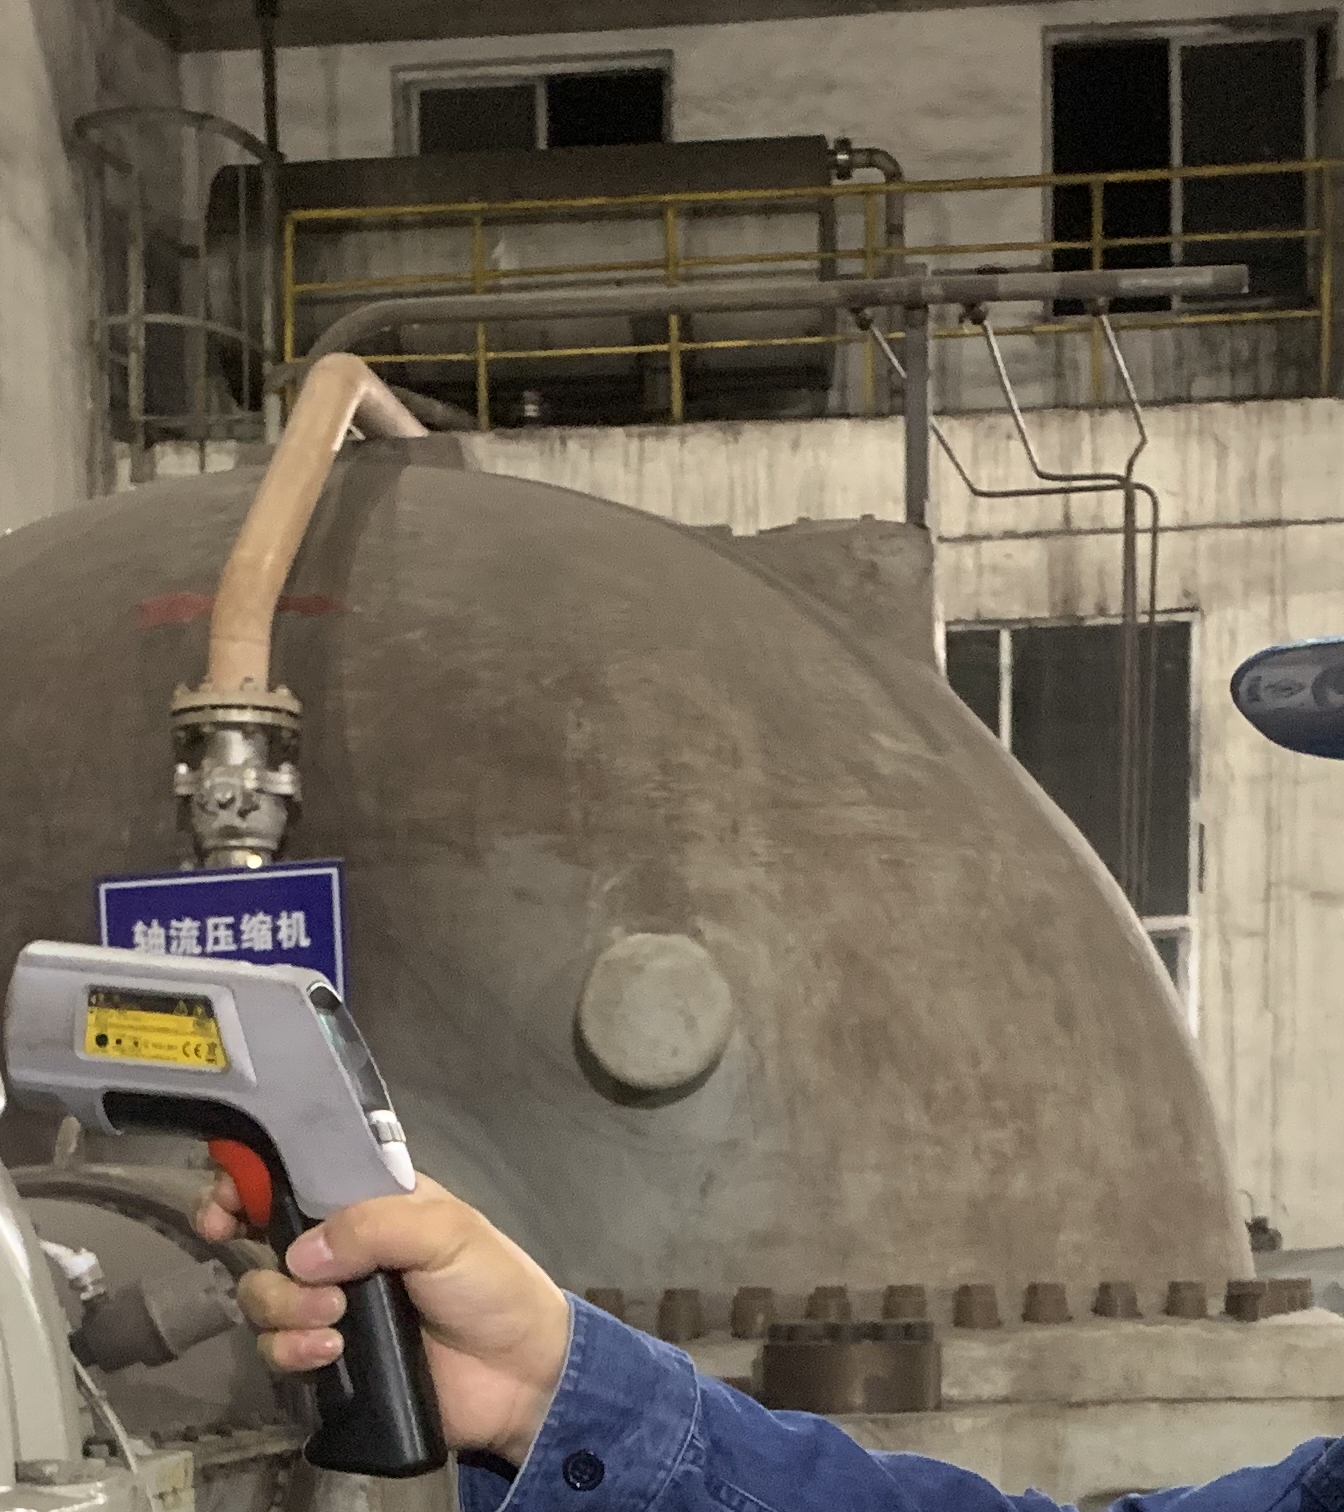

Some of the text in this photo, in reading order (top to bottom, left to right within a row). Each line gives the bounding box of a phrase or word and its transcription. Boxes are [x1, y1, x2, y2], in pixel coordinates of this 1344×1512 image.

[132, 911, 311, 956] 轴流压缩机
